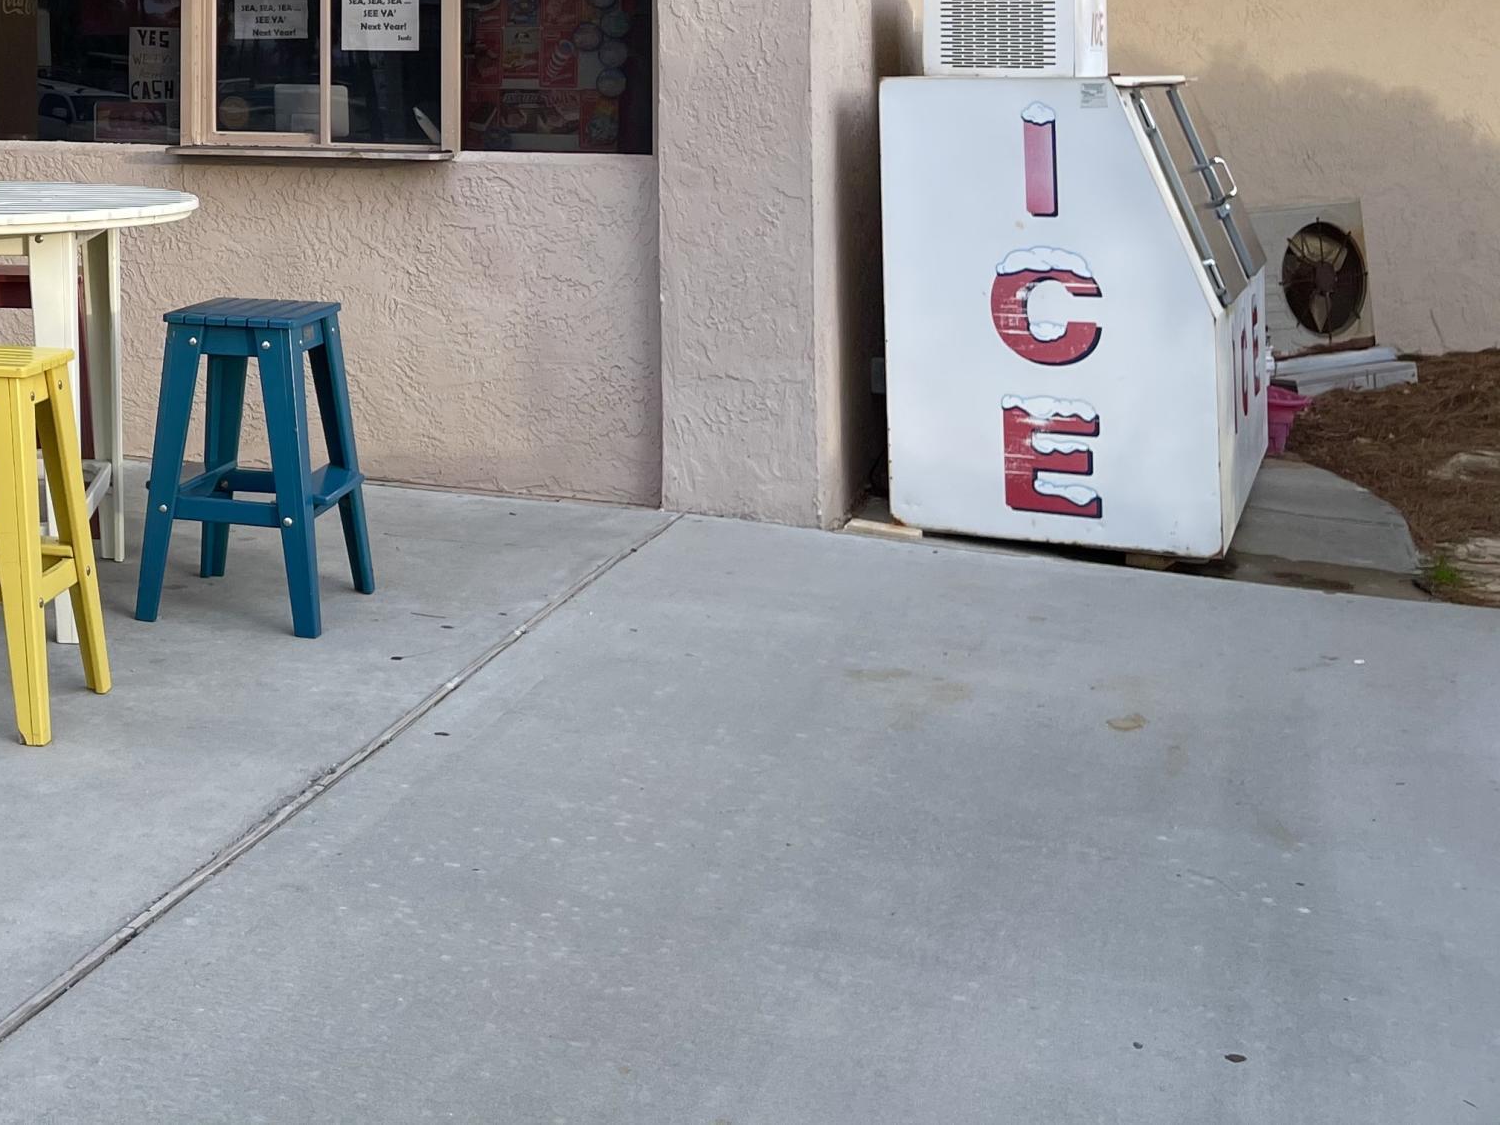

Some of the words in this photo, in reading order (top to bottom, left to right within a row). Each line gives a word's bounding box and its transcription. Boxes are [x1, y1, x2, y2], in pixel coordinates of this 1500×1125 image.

[363, 9, 378, 18] SEE
[255, 16, 269, 24] SEE
[360, 22, 381, 31] Next
[383, 22, 407, 31] Year!
[252, 28, 271, 37] Next
[273, 28, 296, 37] Year!
[137, 29, 169, 48] YES
[131, 80, 174, 100] CASH
[990, 101, 1103, 518] ICE
